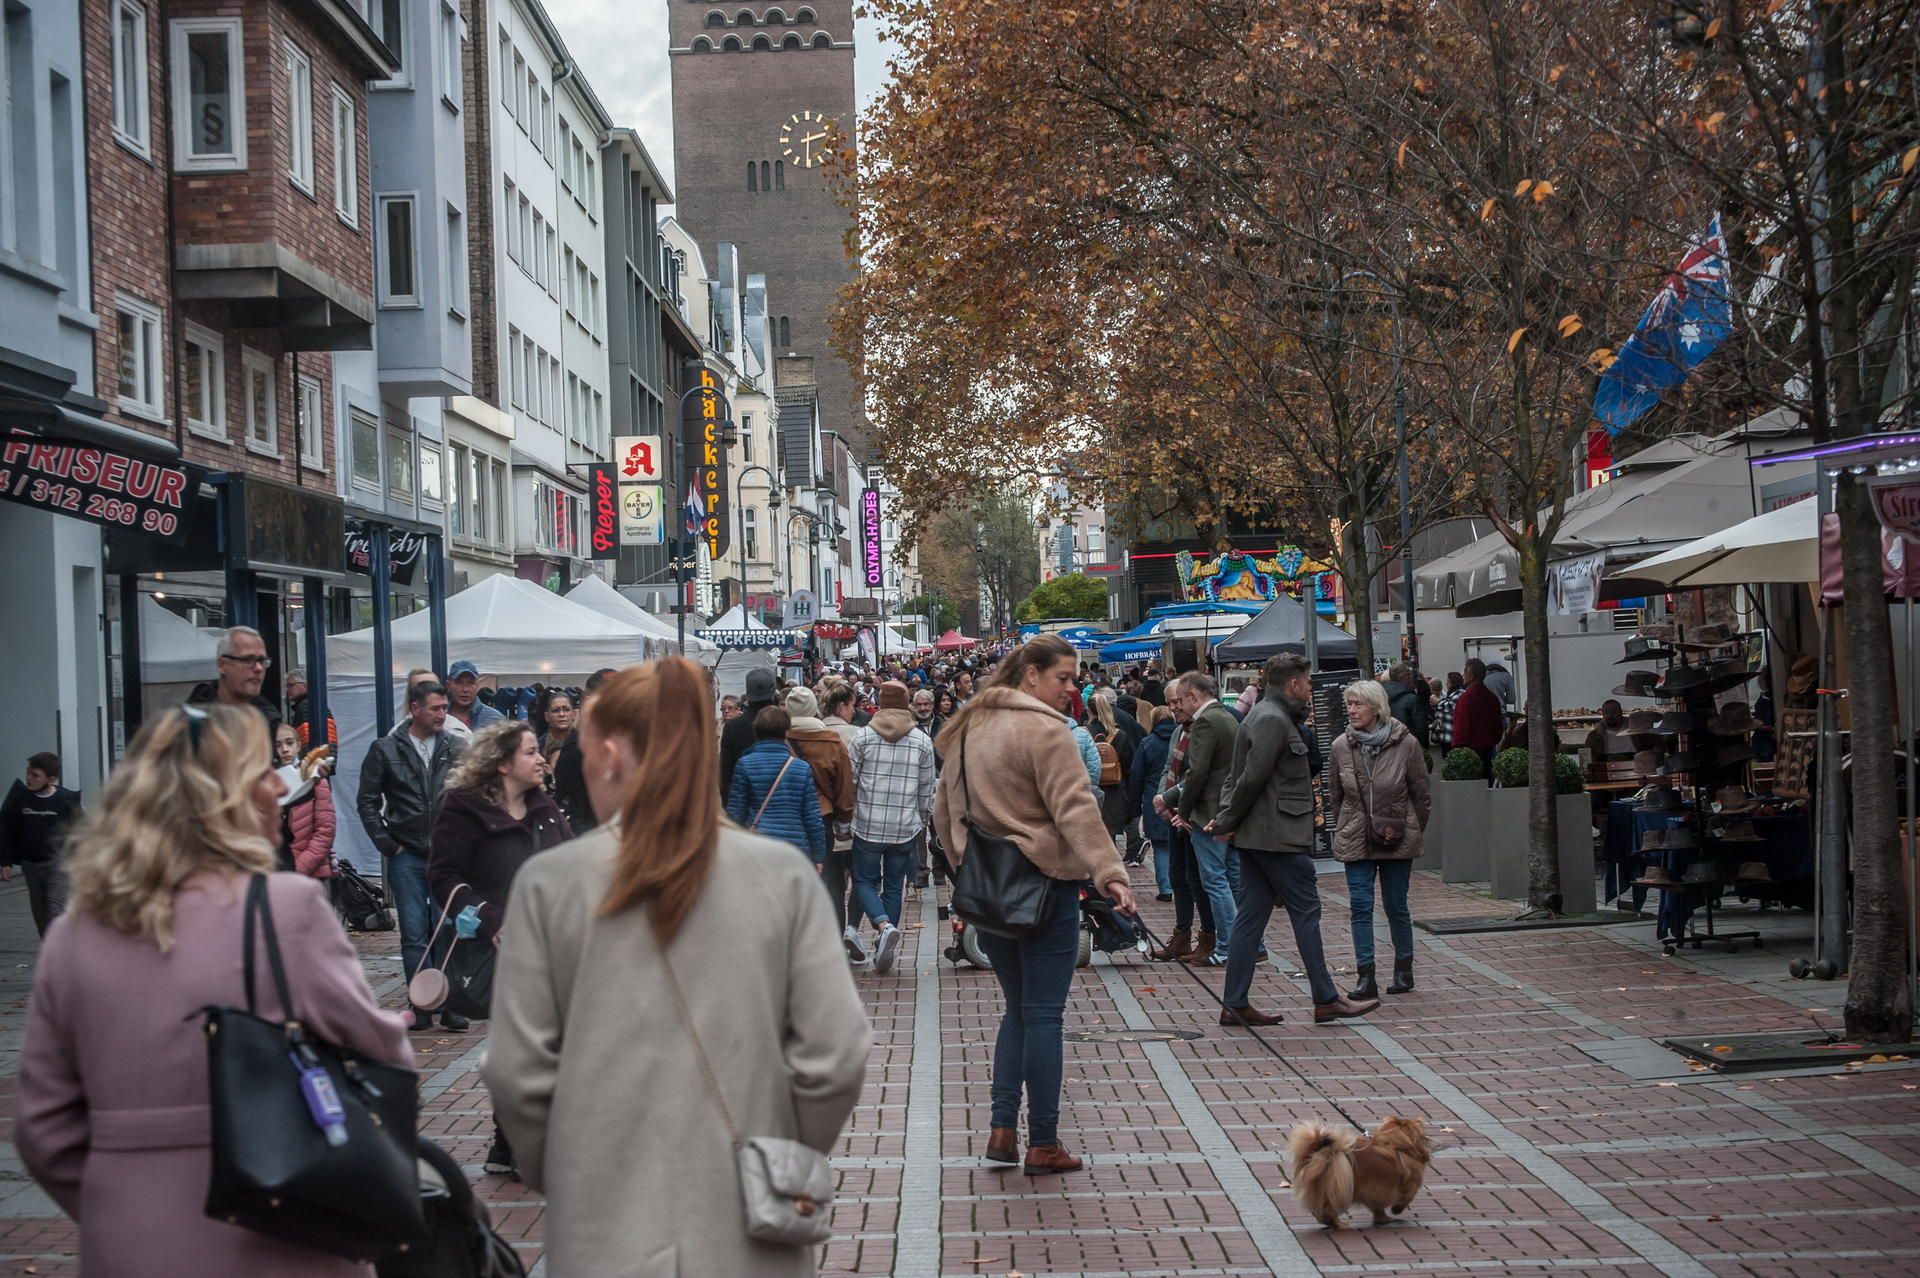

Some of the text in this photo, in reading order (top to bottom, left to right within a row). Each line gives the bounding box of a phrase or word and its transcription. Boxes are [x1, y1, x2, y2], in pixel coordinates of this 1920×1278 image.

[3, 428, 187, 508] FRISEUR
[30, 479, 83, 511] 312
[85, 494, 138, 525] 268
[142, 509, 178, 536] 90
[593, 470, 616, 552] Pieper
[344, 531, 422, 565] Tredy
[704, 634, 786, 646] BACKFISCH
